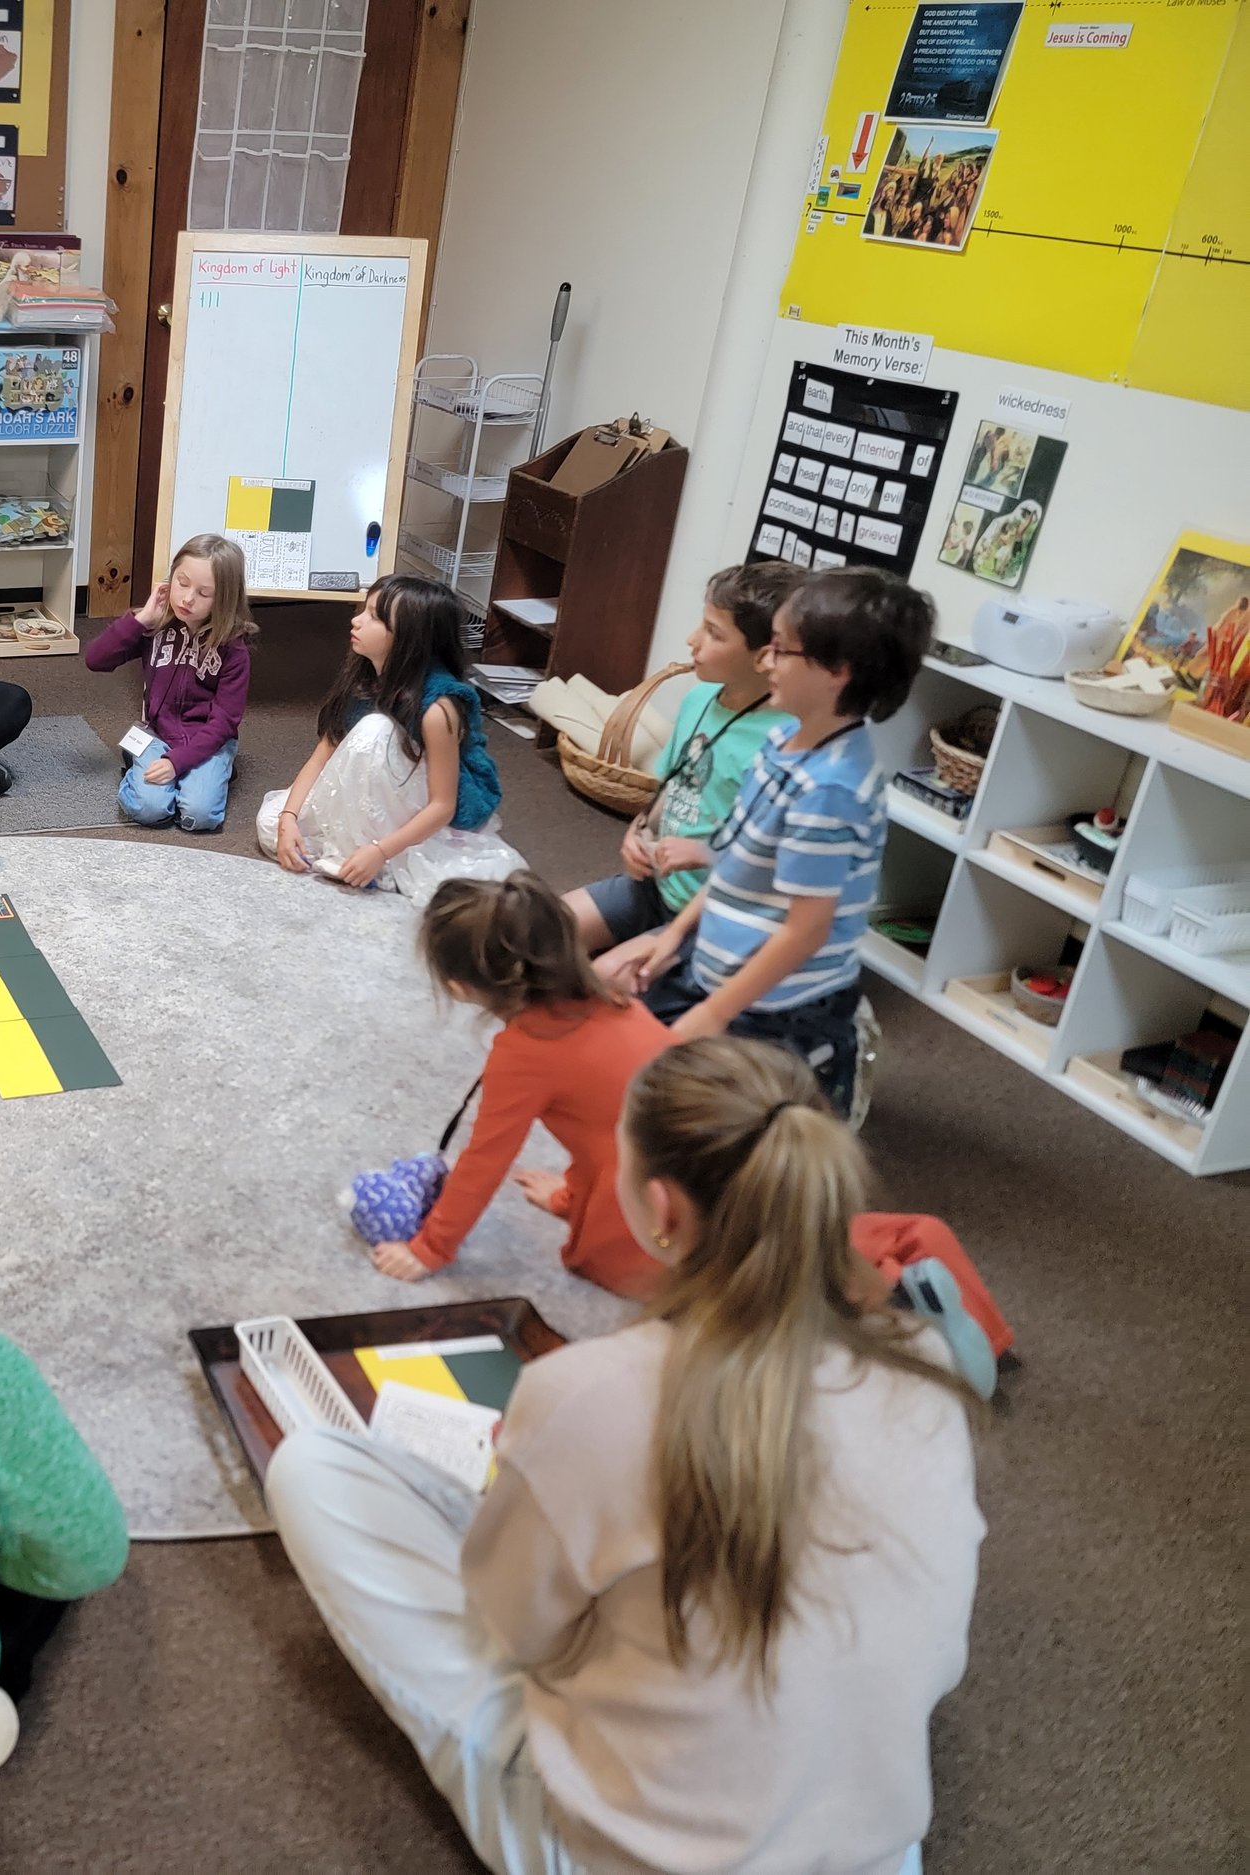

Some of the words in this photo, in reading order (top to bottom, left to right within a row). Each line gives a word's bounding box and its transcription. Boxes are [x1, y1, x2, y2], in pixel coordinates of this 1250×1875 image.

[1047, 31, 1075, 44] Jesus
[1075, 31, 1085, 44] is
[1086, 31, 1128, 47] Coming
[983, 209, 1000, 219] 1500
[1113, 223, 1133, 234] 1000
[1202, 234, 1218, 245] 600
[199, 258, 248, 281] Kingdom
[252, 258, 266, 274] of
[269, 258, 298, 279] Light
[304, 263, 350, 287] Kingdom
[354, 265, 368, 283] of
[368, 268, 407, 284] Darkness
[845, 329, 869, 346] This
[871, 332, 921, 352] Month's
[63, 350, 78, 363] 48
[833, 349, 882, 372] Memory
[884, 355, 924, 375] Verse:
[806, 386, 830, 403] earth,
[998, 393, 1067, 420] wickedness
[47, 411, 76, 424] ARK
[33, 423, 75, 434] PUZZLE
[787, 419, 804, 433] and
[805, 424, 823, 438] that
[825, 430, 851, 447] every
[857, 440, 901, 461] intention
[916, 454, 931, 467] of
[778, 461, 791, 474] his
[799, 467, 820, 482] heart
[826, 476, 846, 490] was
[851, 481, 872, 499] only
[883, 490, 902, 505] evil
[818, 512, 836, 529] And
[858, 525, 898, 545] grieved
